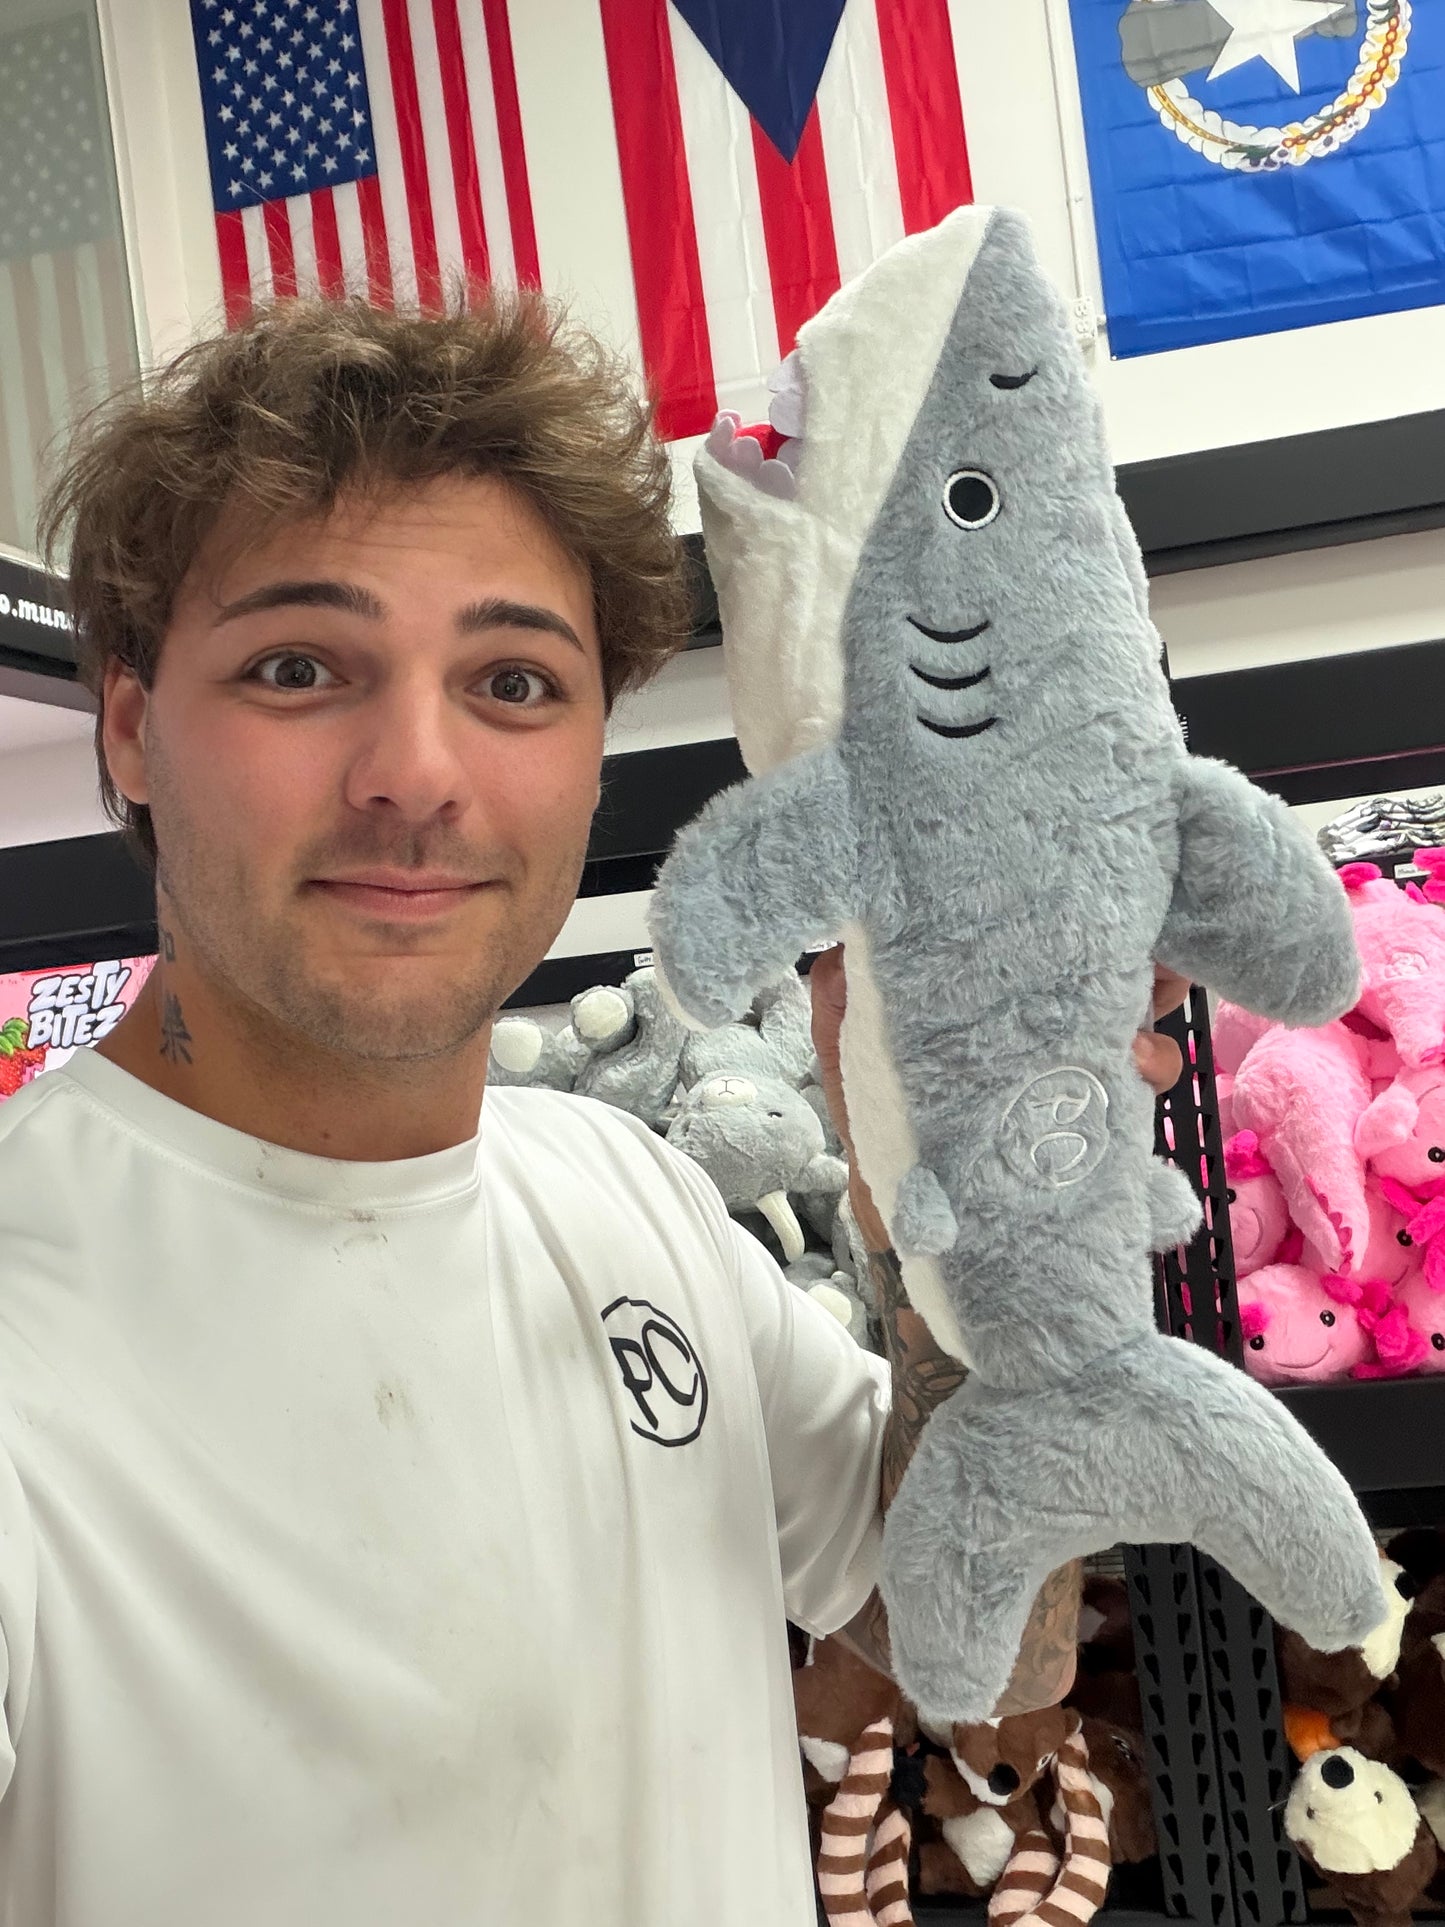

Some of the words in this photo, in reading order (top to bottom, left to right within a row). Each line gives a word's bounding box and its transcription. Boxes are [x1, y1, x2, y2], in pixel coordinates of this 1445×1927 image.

[28, 959, 132, 1013] ZESTY
[27, 1002, 126, 1049] BITEZ
[608, 1319, 699, 1431] PC
